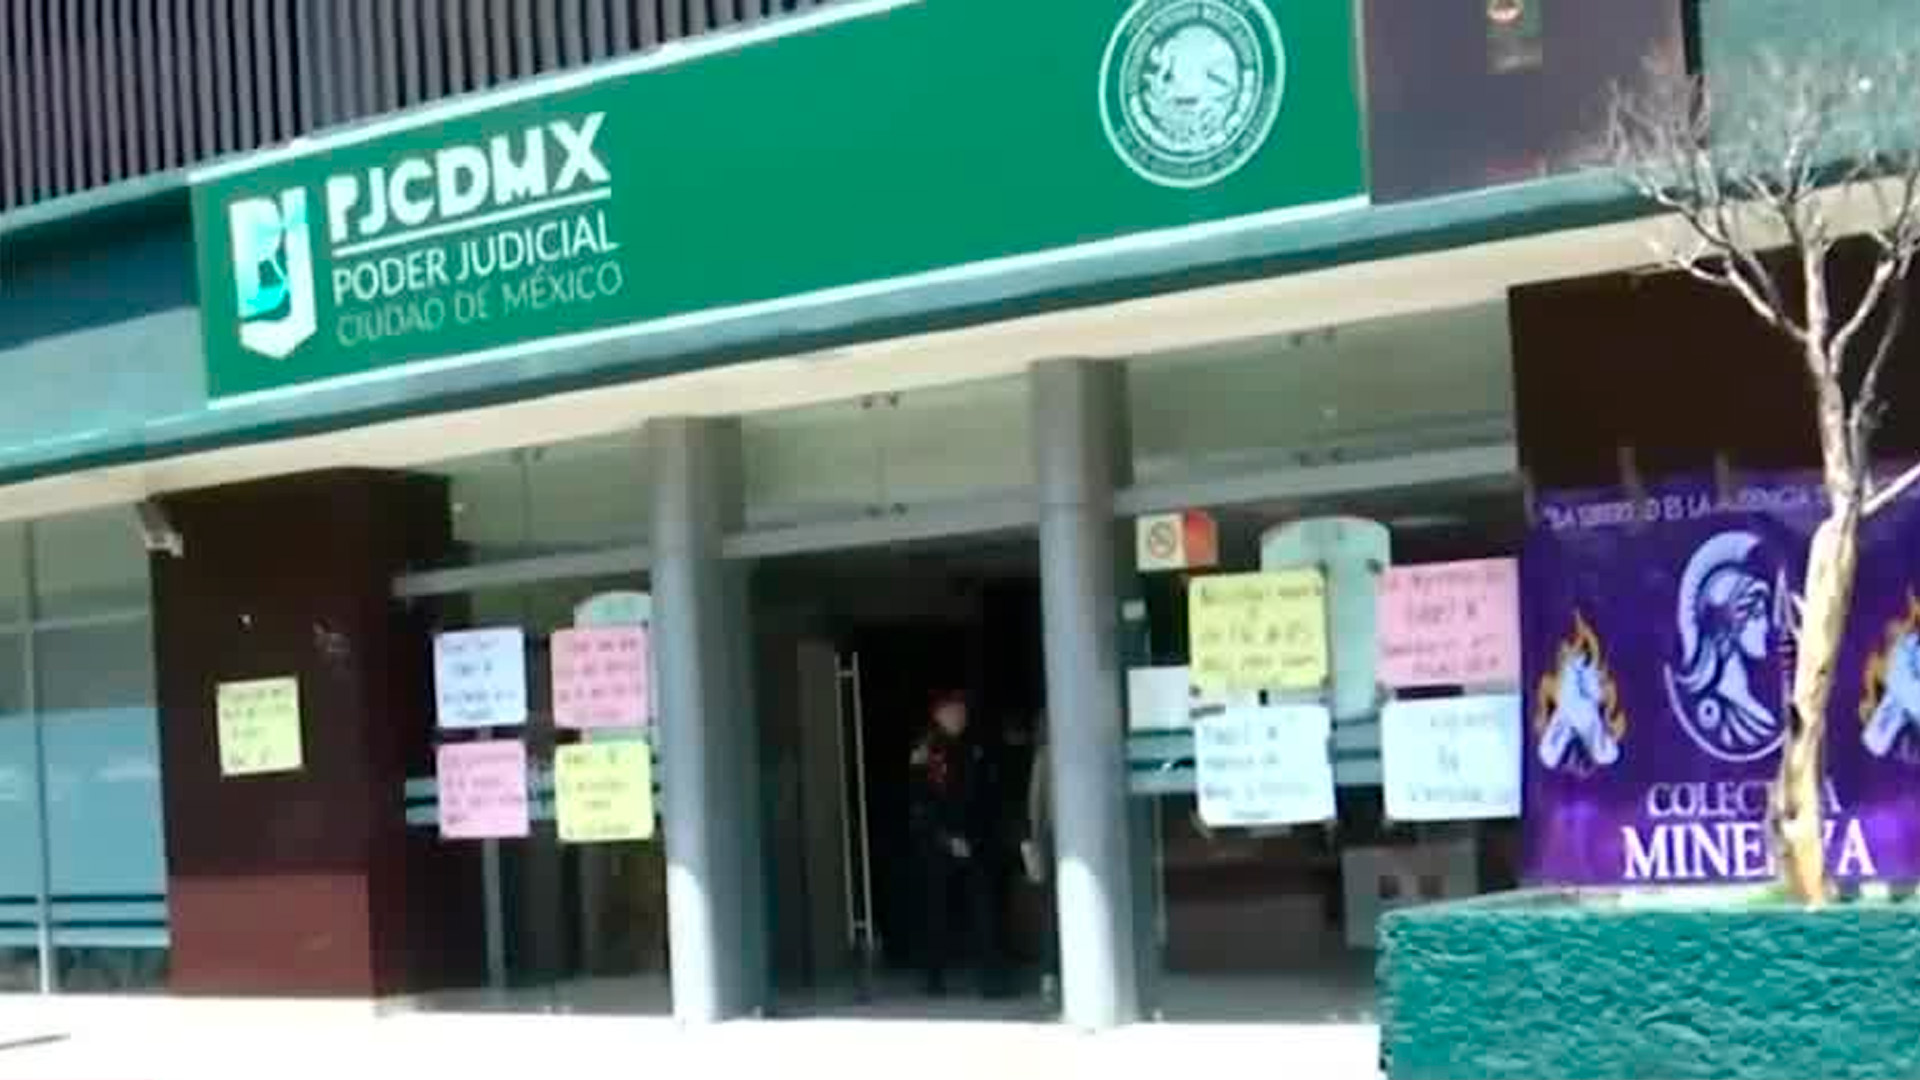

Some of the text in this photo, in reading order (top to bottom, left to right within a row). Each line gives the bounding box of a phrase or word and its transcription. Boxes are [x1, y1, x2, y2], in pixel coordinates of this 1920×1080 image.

[324, 112, 611, 243] PJCDMX
[332, 211, 620, 306] PODER JUDICIAL
[336, 260, 624, 347] CIUDAD DE MÉXICO
